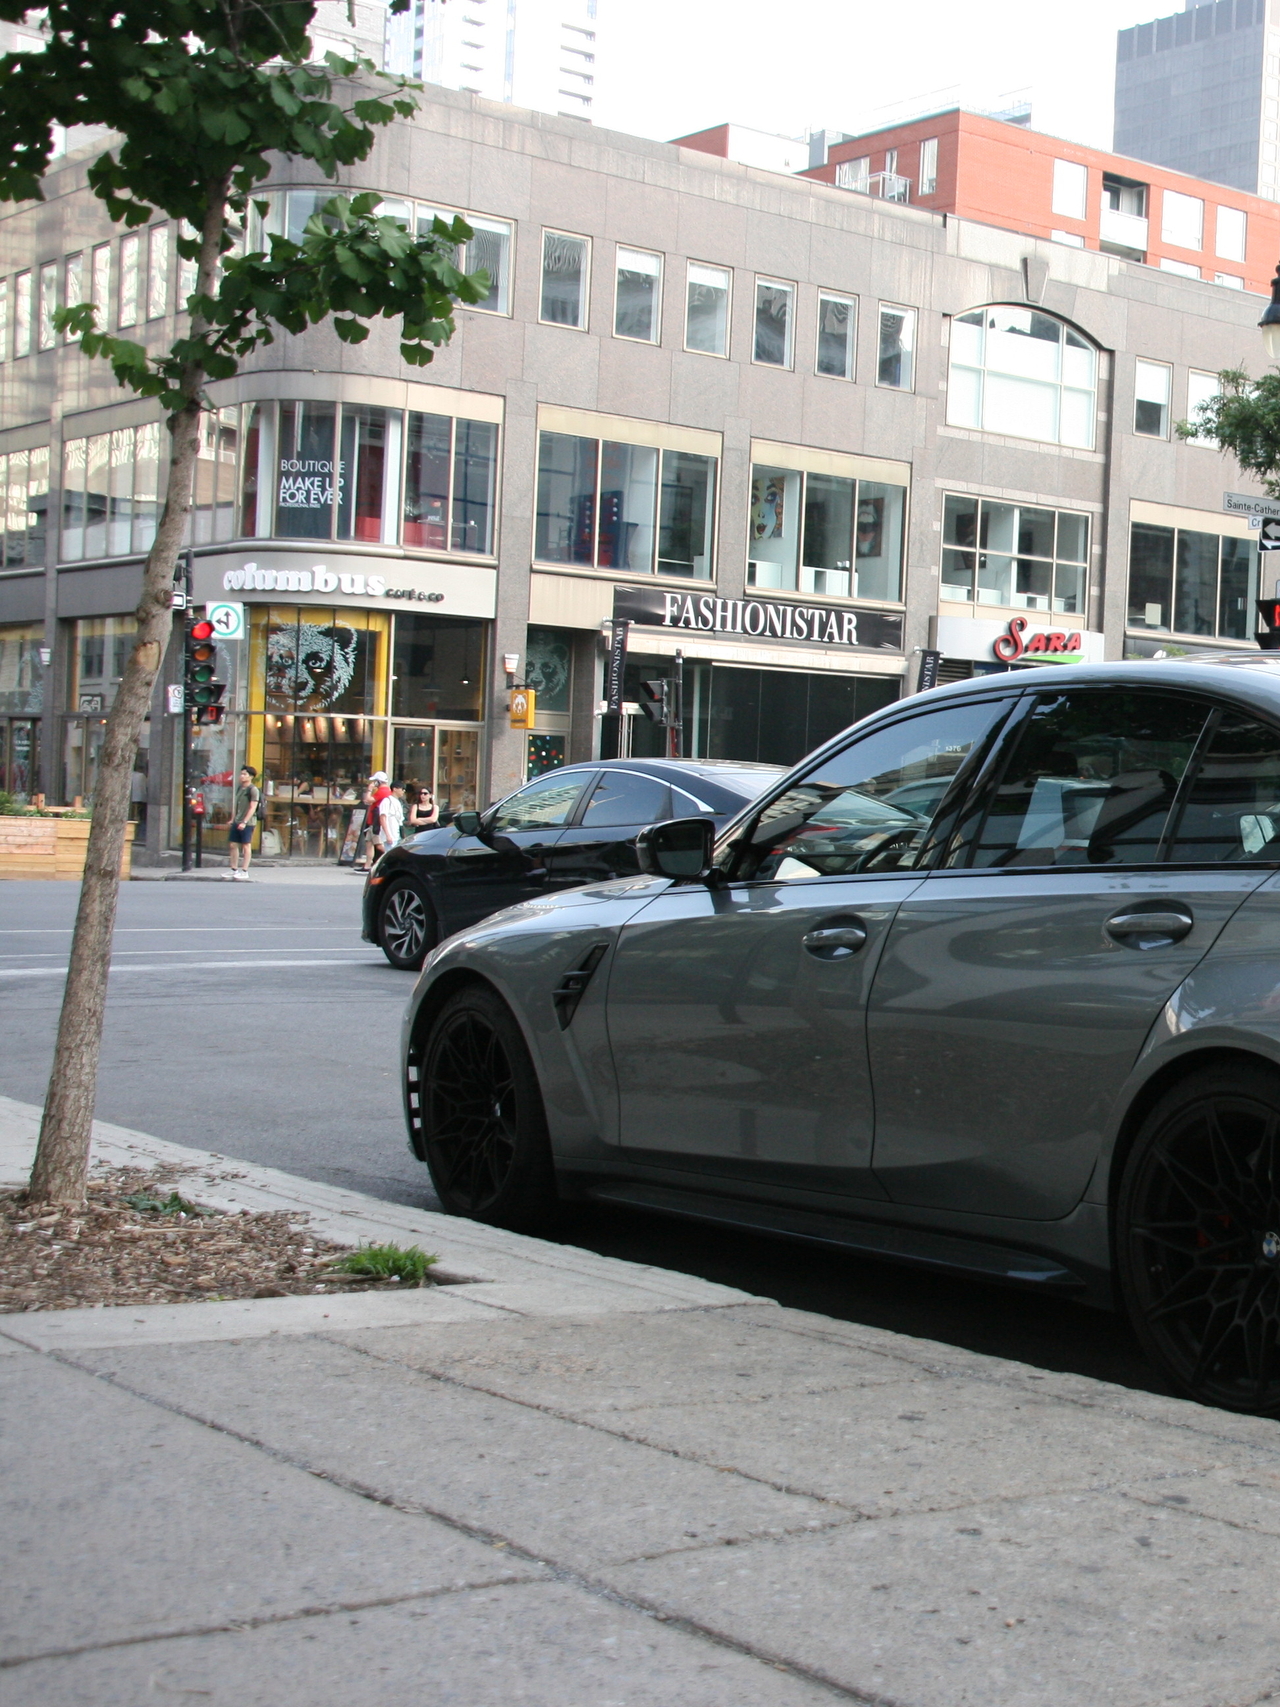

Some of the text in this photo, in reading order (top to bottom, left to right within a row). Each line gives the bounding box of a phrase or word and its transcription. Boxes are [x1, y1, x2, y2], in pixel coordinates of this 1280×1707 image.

[281, 459, 346, 473] BOUTIQUE
[280, 476, 322, 491] MAKE
[280, 489, 343, 505] FOR EVER
[222, 562, 386, 597] columbus
[662, 592, 859, 645] FASHIONISTAR
[610, 627, 623, 709] FASHIONISTAR
